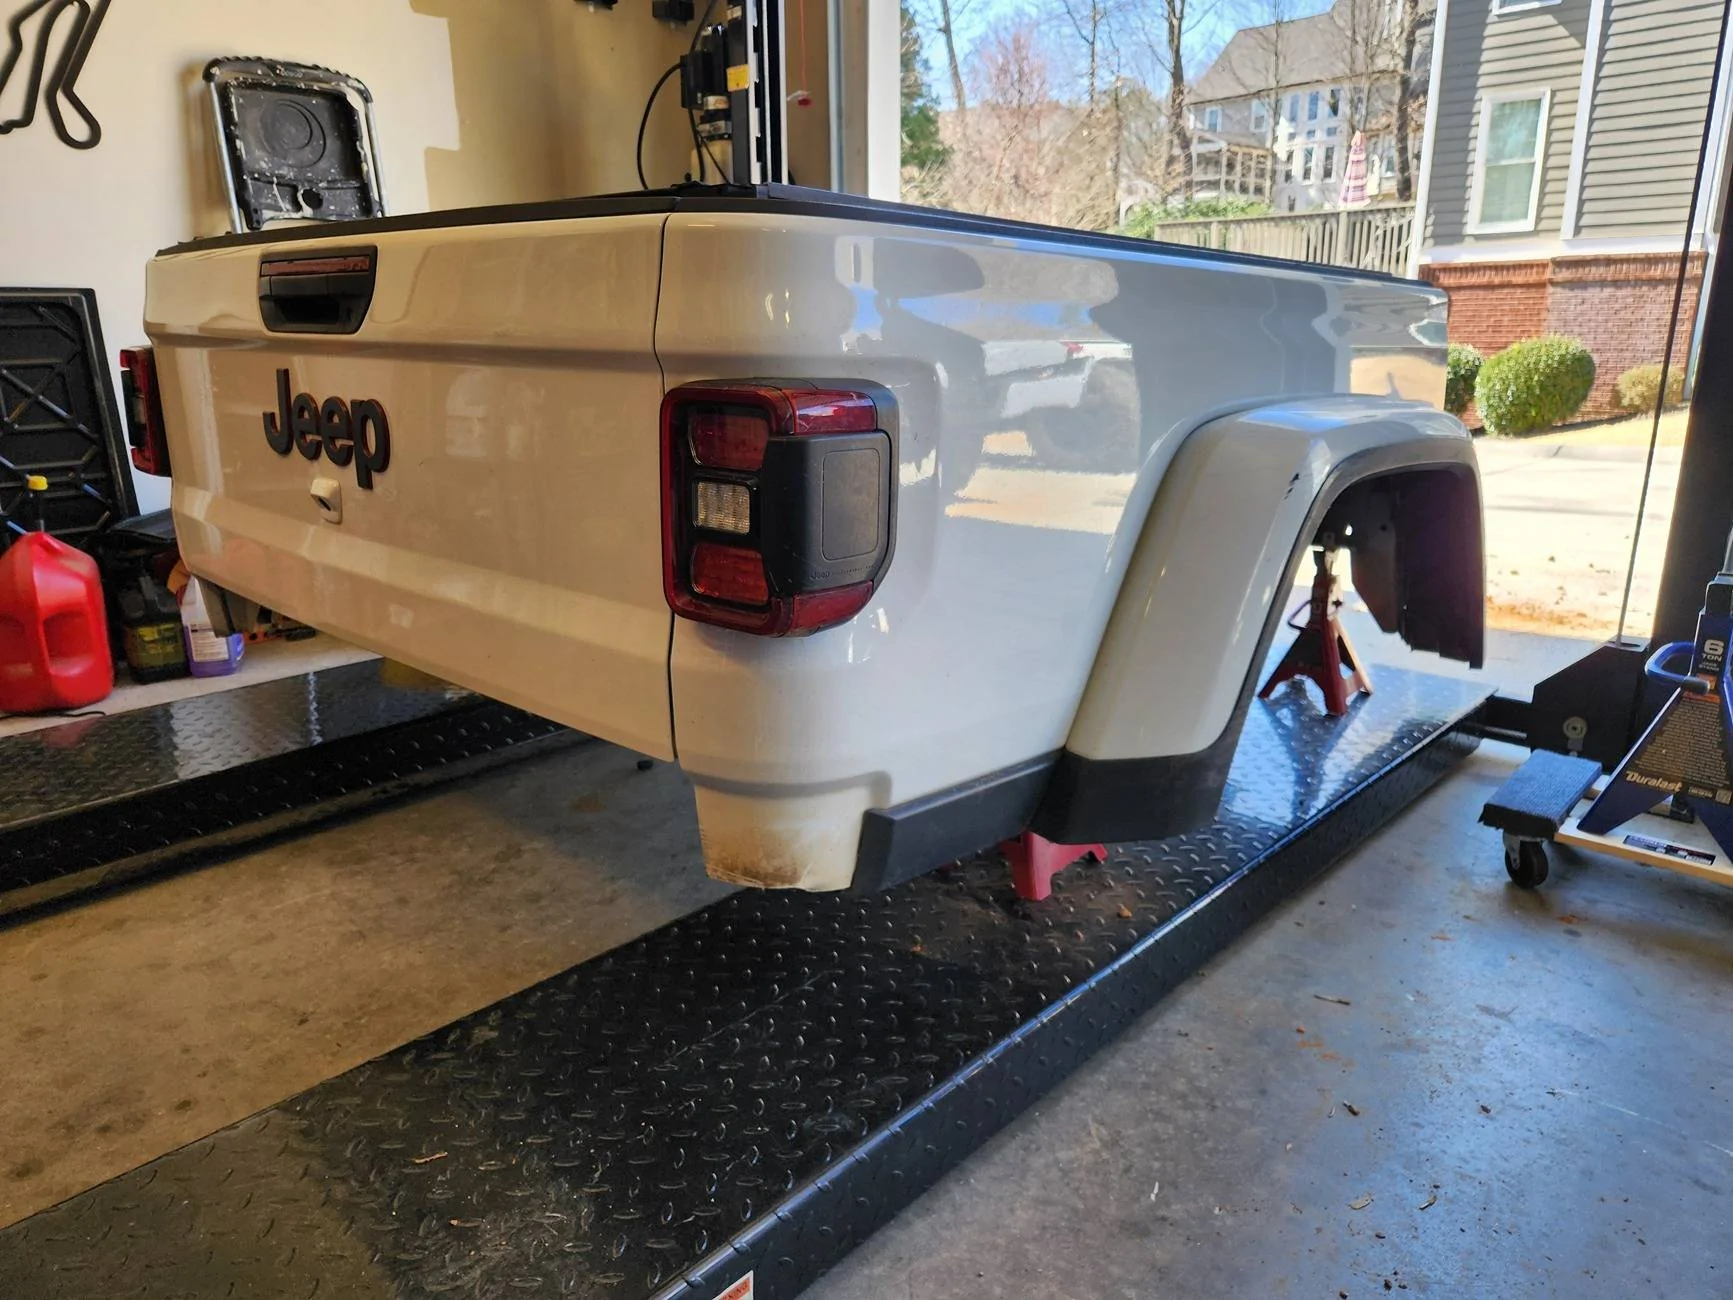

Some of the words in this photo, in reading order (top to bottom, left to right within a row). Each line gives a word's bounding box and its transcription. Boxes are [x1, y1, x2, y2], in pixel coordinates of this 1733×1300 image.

[262, 368, 391, 490] Jeep
[1701, 653, 1723, 662] TON
[1703, 639, 1725, 656] 6
[1625, 770, 1683, 793] Duralast
